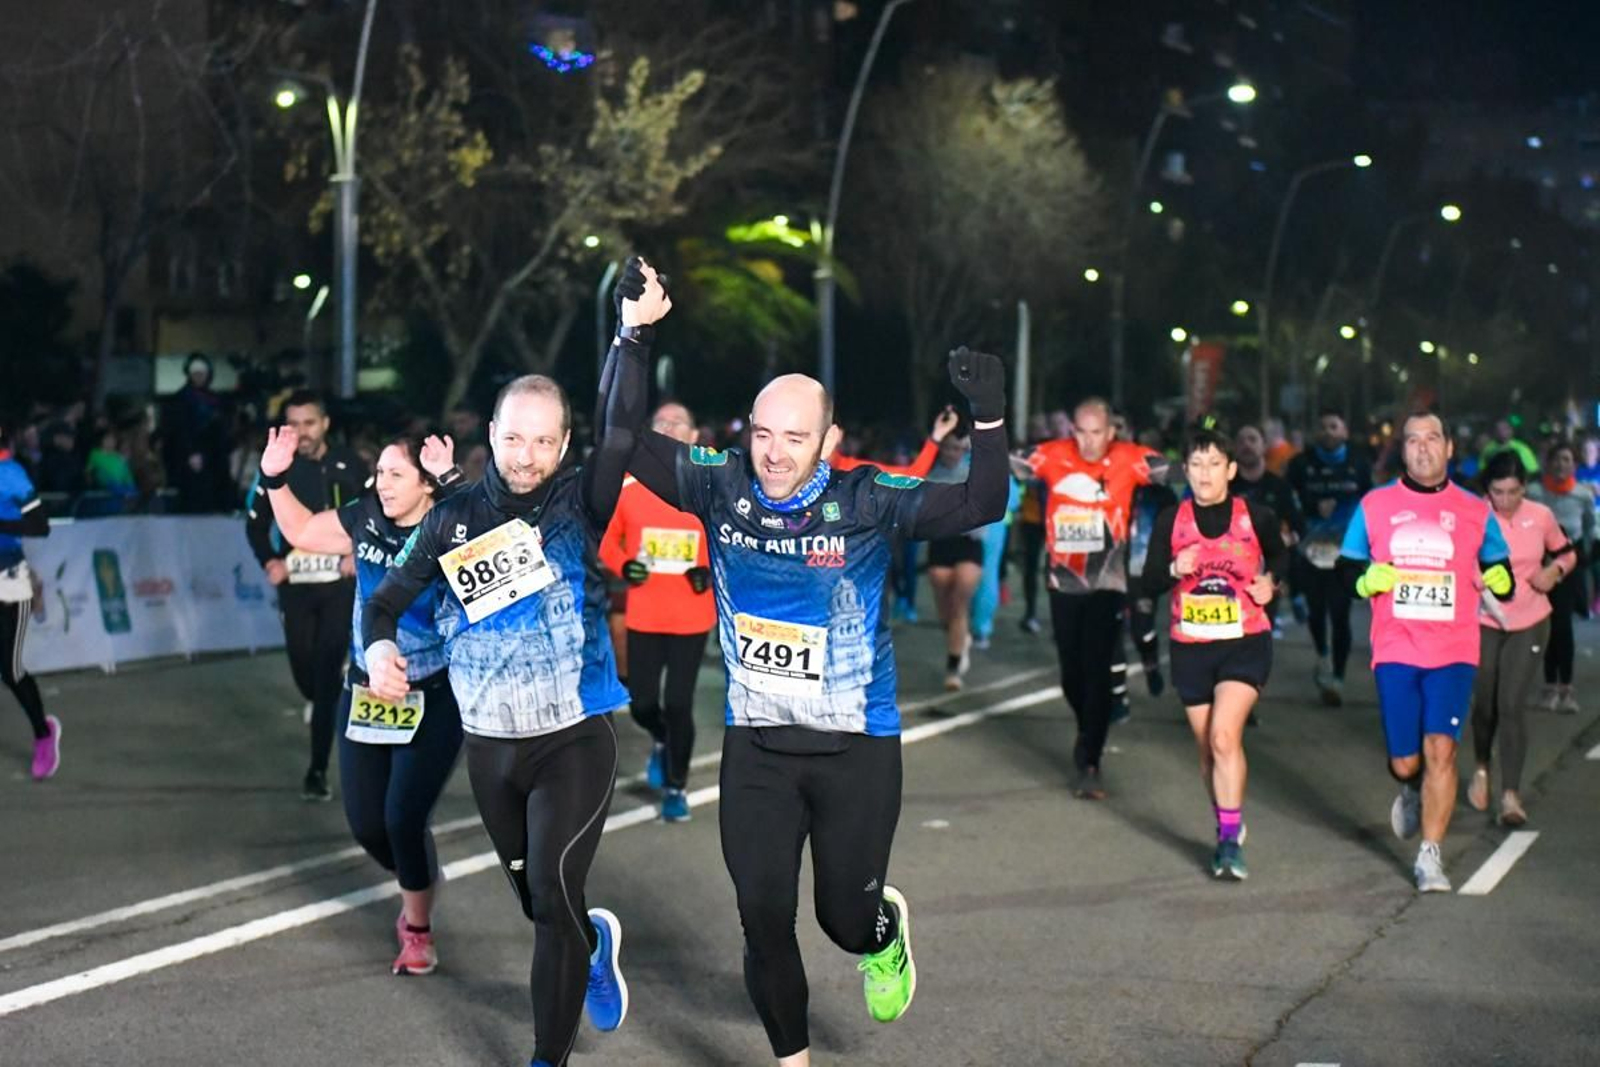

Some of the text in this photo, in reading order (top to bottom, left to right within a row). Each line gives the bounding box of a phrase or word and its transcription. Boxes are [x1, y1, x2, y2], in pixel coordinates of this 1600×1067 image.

[719, 523, 758, 550] SAN
[357, 541, 384, 568] SAN
[806, 550, 846, 567] 2025
[1399, 584, 1449, 603] 8743
[1185, 604, 1232, 623] 3541
[739, 635, 811, 670] 7491
[357, 701, 416, 725] 3212
